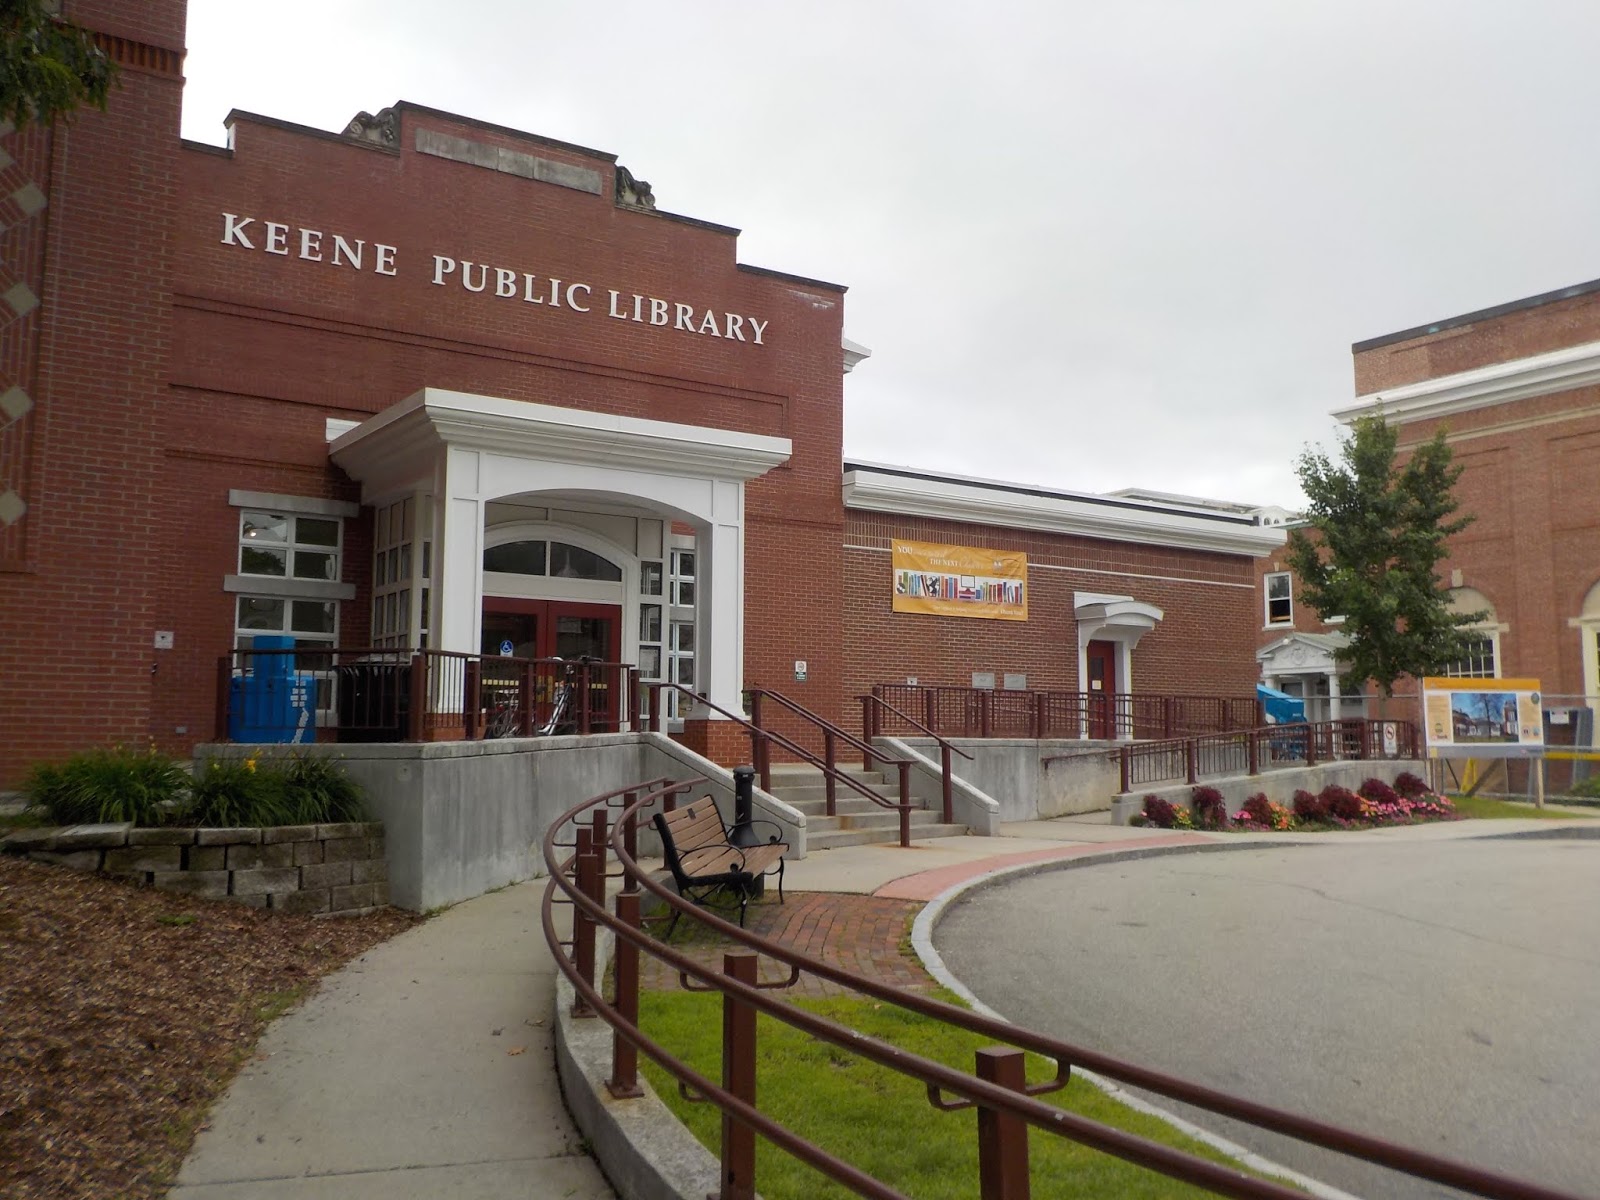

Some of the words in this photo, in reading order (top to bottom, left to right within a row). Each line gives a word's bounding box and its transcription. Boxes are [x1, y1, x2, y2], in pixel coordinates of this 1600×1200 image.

[220, 211, 398, 276] KEENE
[431, 254, 592, 312] PUBLIC
[608, 289, 769, 345] LIBRARY
[897, 545, 913, 555] YOU
